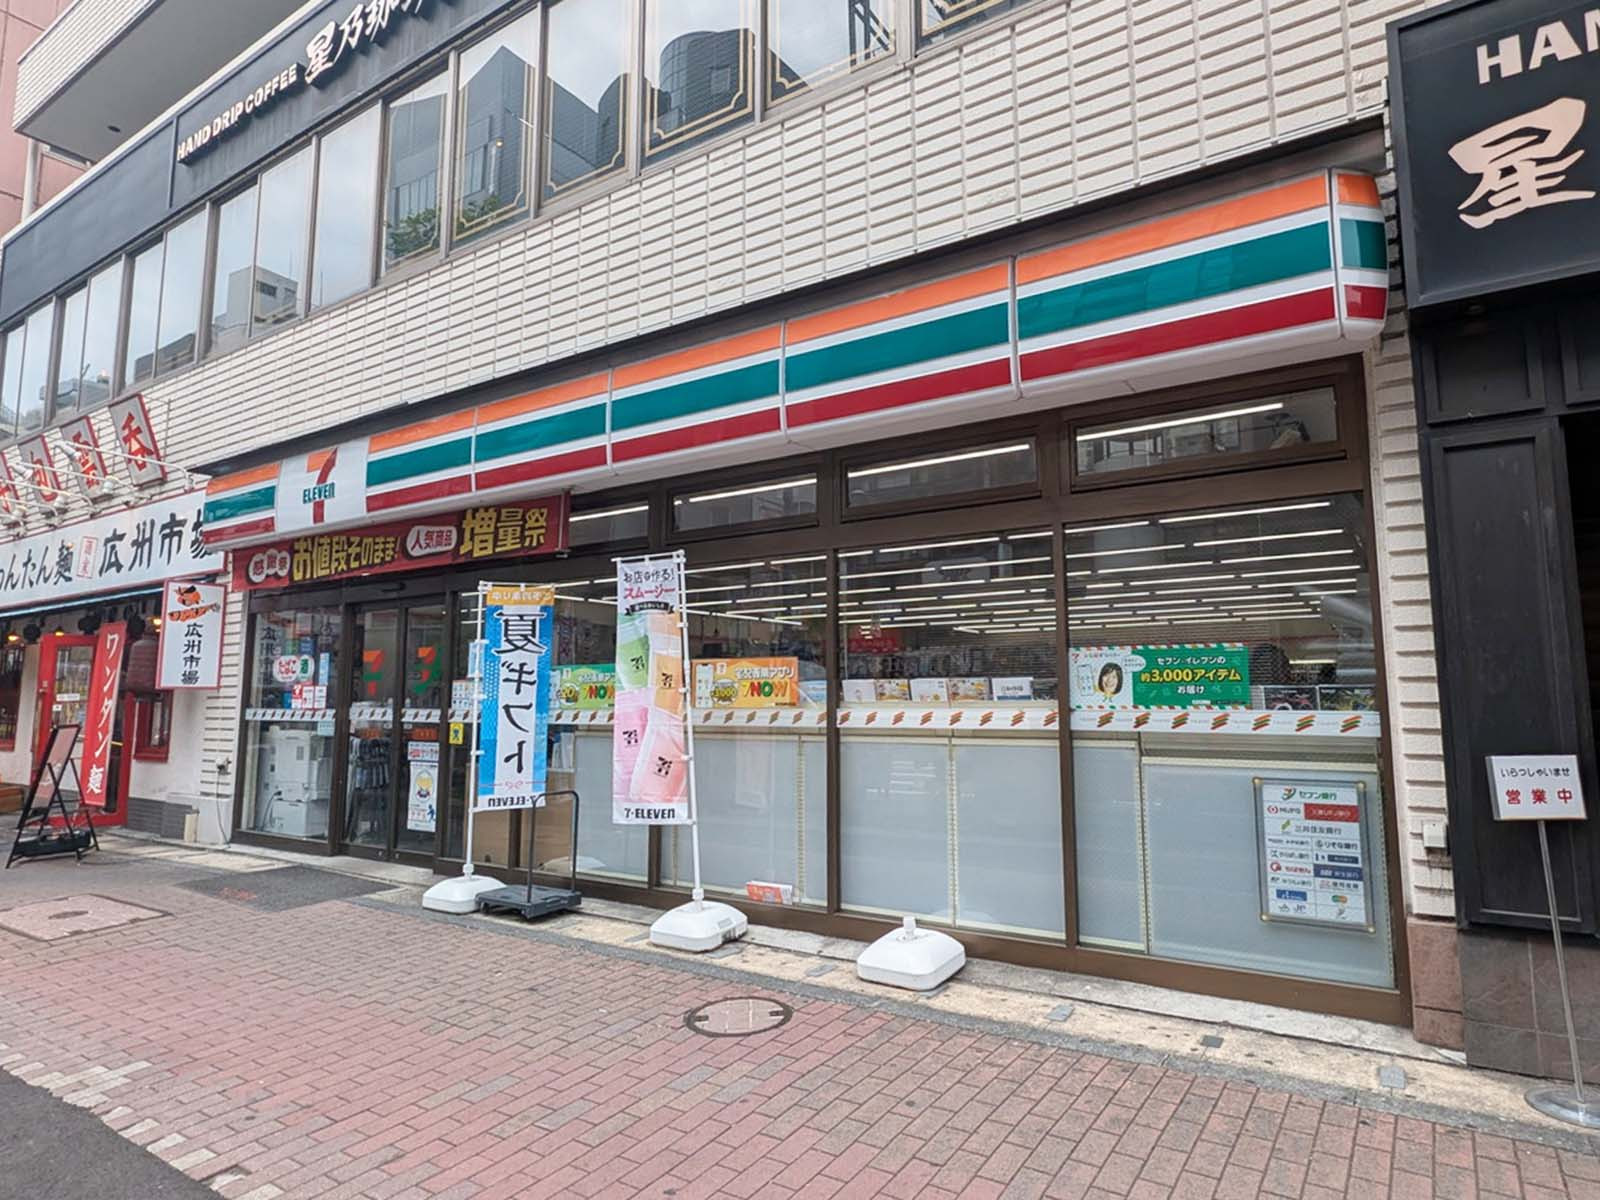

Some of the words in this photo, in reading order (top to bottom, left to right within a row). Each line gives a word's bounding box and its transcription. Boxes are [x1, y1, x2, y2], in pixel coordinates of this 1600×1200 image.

[304, 0, 422, 84] 星乃珈
[177, 125, 211, 161] HAND
[211, 101, 244, 137] DRIP
[244, 63, 298, 114] COFFEE
[1448, 97, 1596, 229] 星
[410, 529, 453, 552] 人気商品
[459, 507, 549, 558] 増量祭
[0, 539, 73, 591] んたん麺
[624, 584, 676, 599] スムージー
[180, 622, 203, 686] 広州市場
[86, 632, 120, 795] ワンタン麺
[1177, 684, 1205, 695] お届け
[1299, 790, 1338, 801] セブン銀行
[1505, 788, 1573, 805] 営業中
